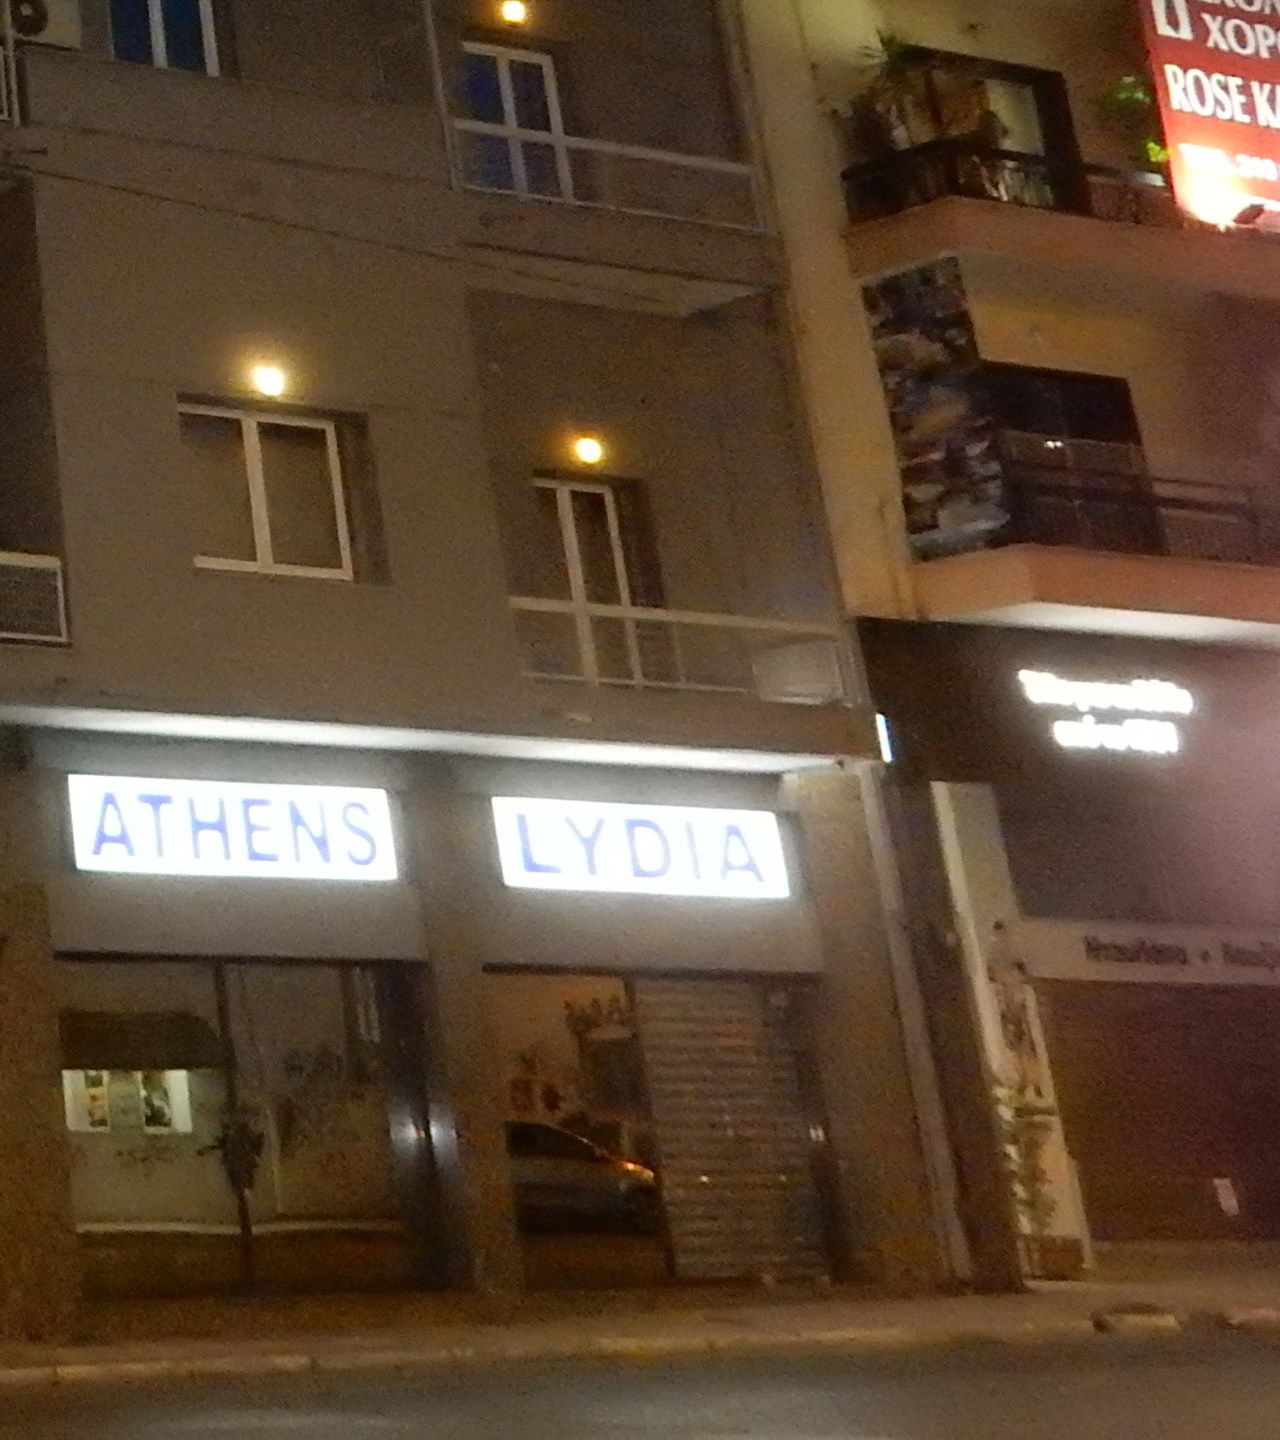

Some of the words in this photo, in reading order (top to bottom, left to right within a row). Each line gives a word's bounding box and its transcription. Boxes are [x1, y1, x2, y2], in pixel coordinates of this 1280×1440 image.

[1201, 12, 1280, 59] ΧΟΡ
[1164, 63, 1252, 123] ROSE
[91, 791, 378, 867] ATHENS
[517, 813, 766, 883] LYDIA
